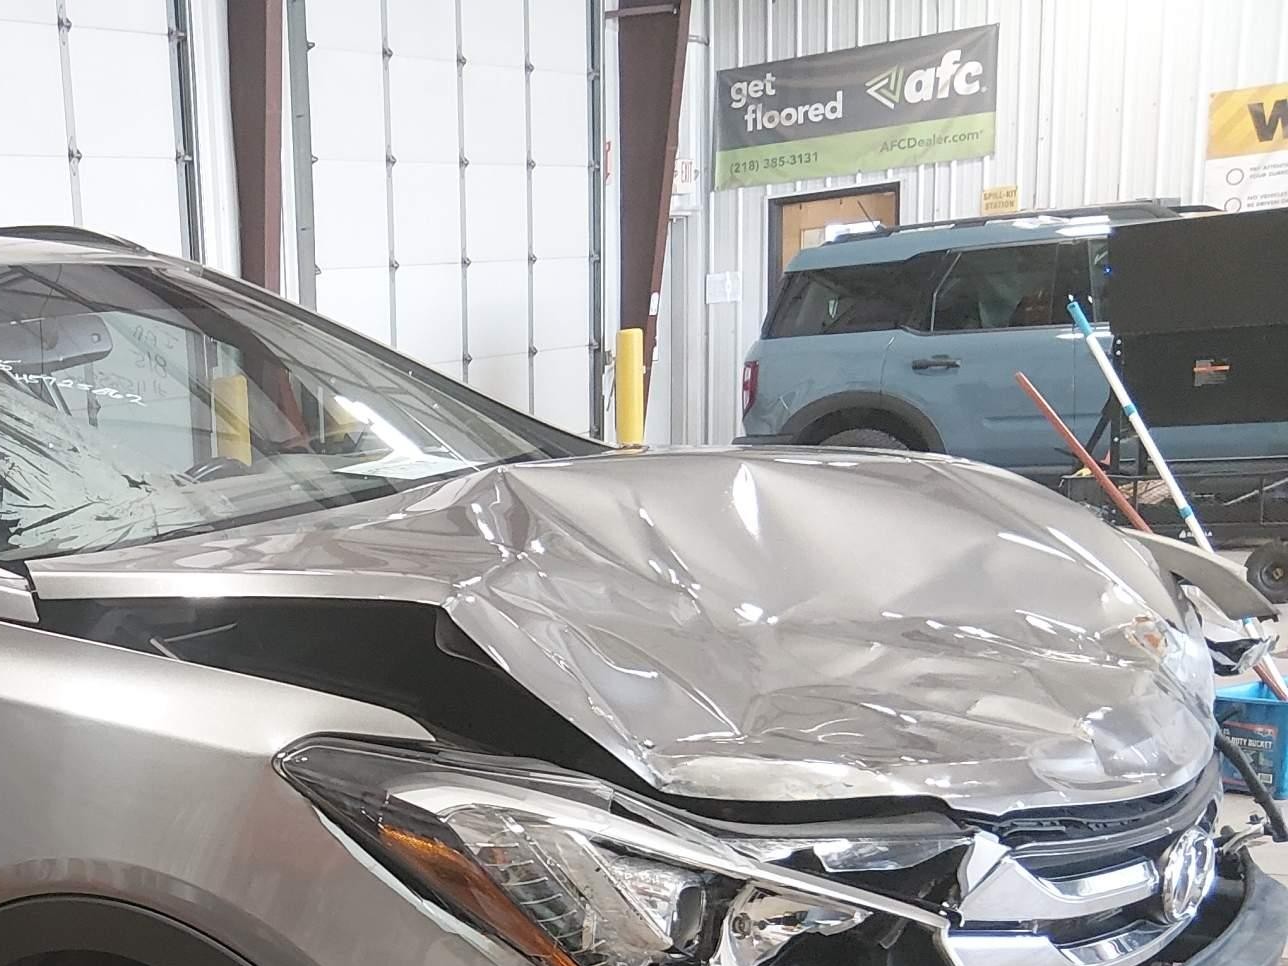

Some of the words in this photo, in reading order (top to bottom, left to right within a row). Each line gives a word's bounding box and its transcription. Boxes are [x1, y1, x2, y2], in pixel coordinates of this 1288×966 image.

[730, 73, 776, 108] get
[904, 49, 983, 103] afc
[744, 90, 843, 132] floored
[681, 161, 693, 184] EXIT
[729, 159, 759, 174] (218)
[763, 151, 819, 169] 385-3131
[984, 200, 1015, 211] STATION
